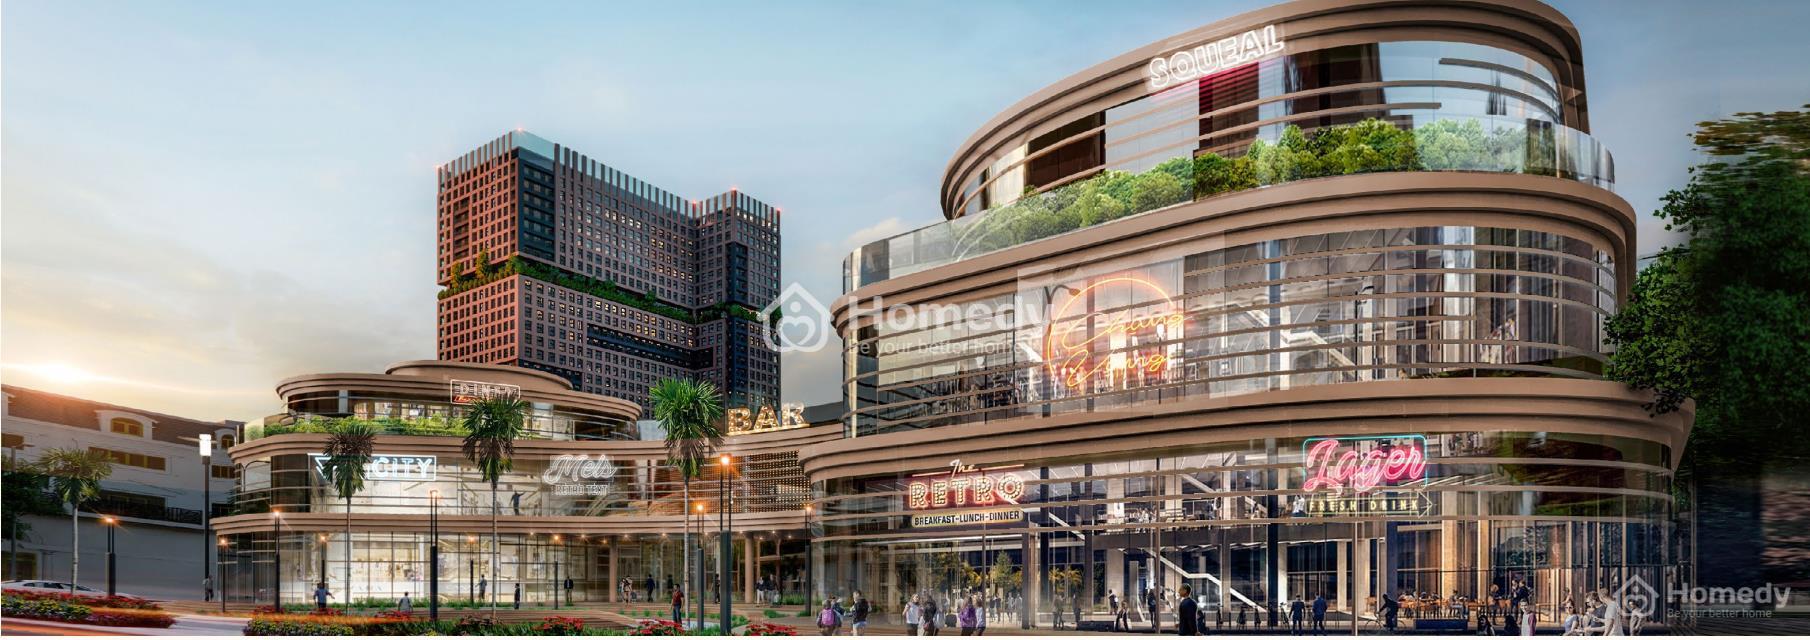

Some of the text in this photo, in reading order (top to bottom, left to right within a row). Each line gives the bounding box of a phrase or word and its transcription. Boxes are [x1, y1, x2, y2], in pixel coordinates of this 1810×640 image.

[1149, 24, 1285, 88] SQUEAL
[727, 402, 806, 433] BAR
[371, 457, 432, 478] CITY
[543, 454, 618, 485] Mels
[950, 459, 976, 477] The
[1302, 439, 1427, 493] Lager
[909, 472, 1024, 509] RETRO
[1309, 500, 1419, 512] FRESH DRINK
